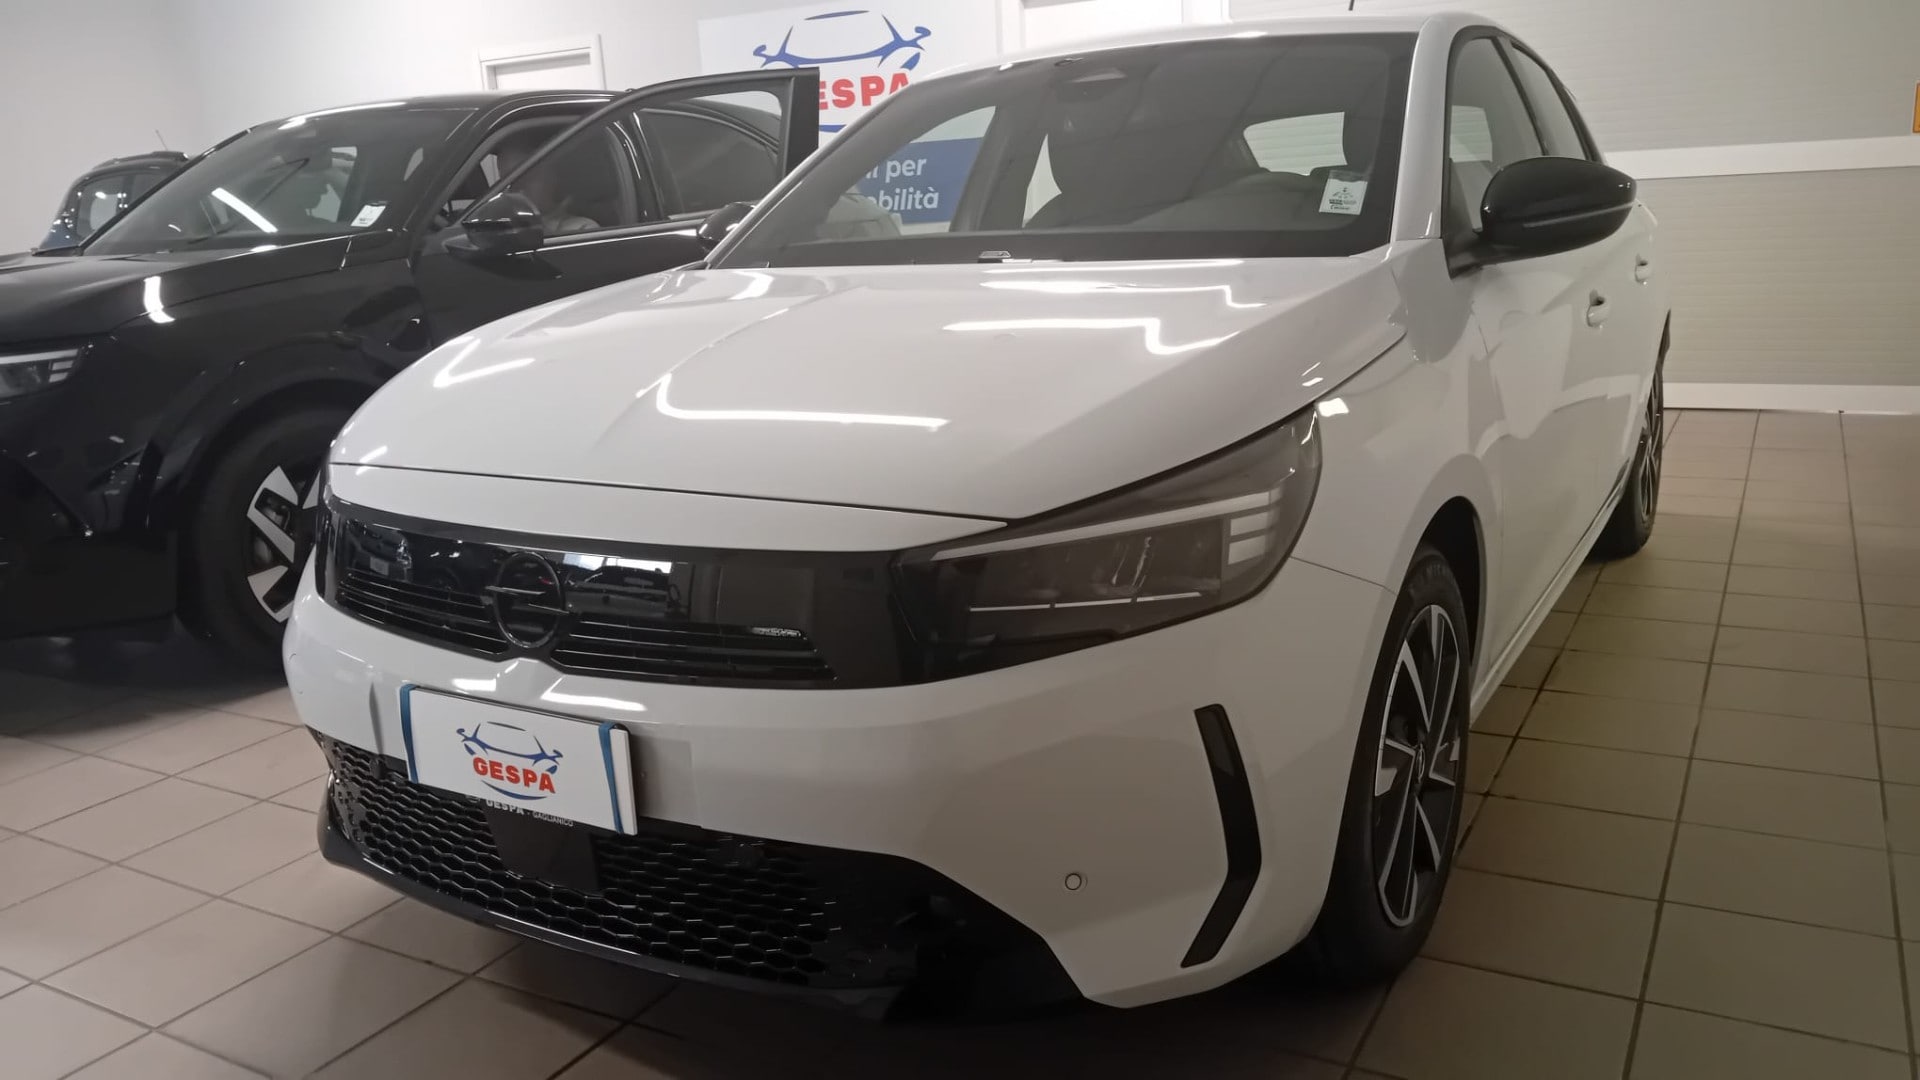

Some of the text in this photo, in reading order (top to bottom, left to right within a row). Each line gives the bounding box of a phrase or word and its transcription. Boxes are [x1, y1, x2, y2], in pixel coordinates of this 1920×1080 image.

[819, 73, 909, 110] ESPA
[885, 158, 927, 183] per
[868, 186, 939, 211] bilità
[472, 757, 556, 794] GESPA
